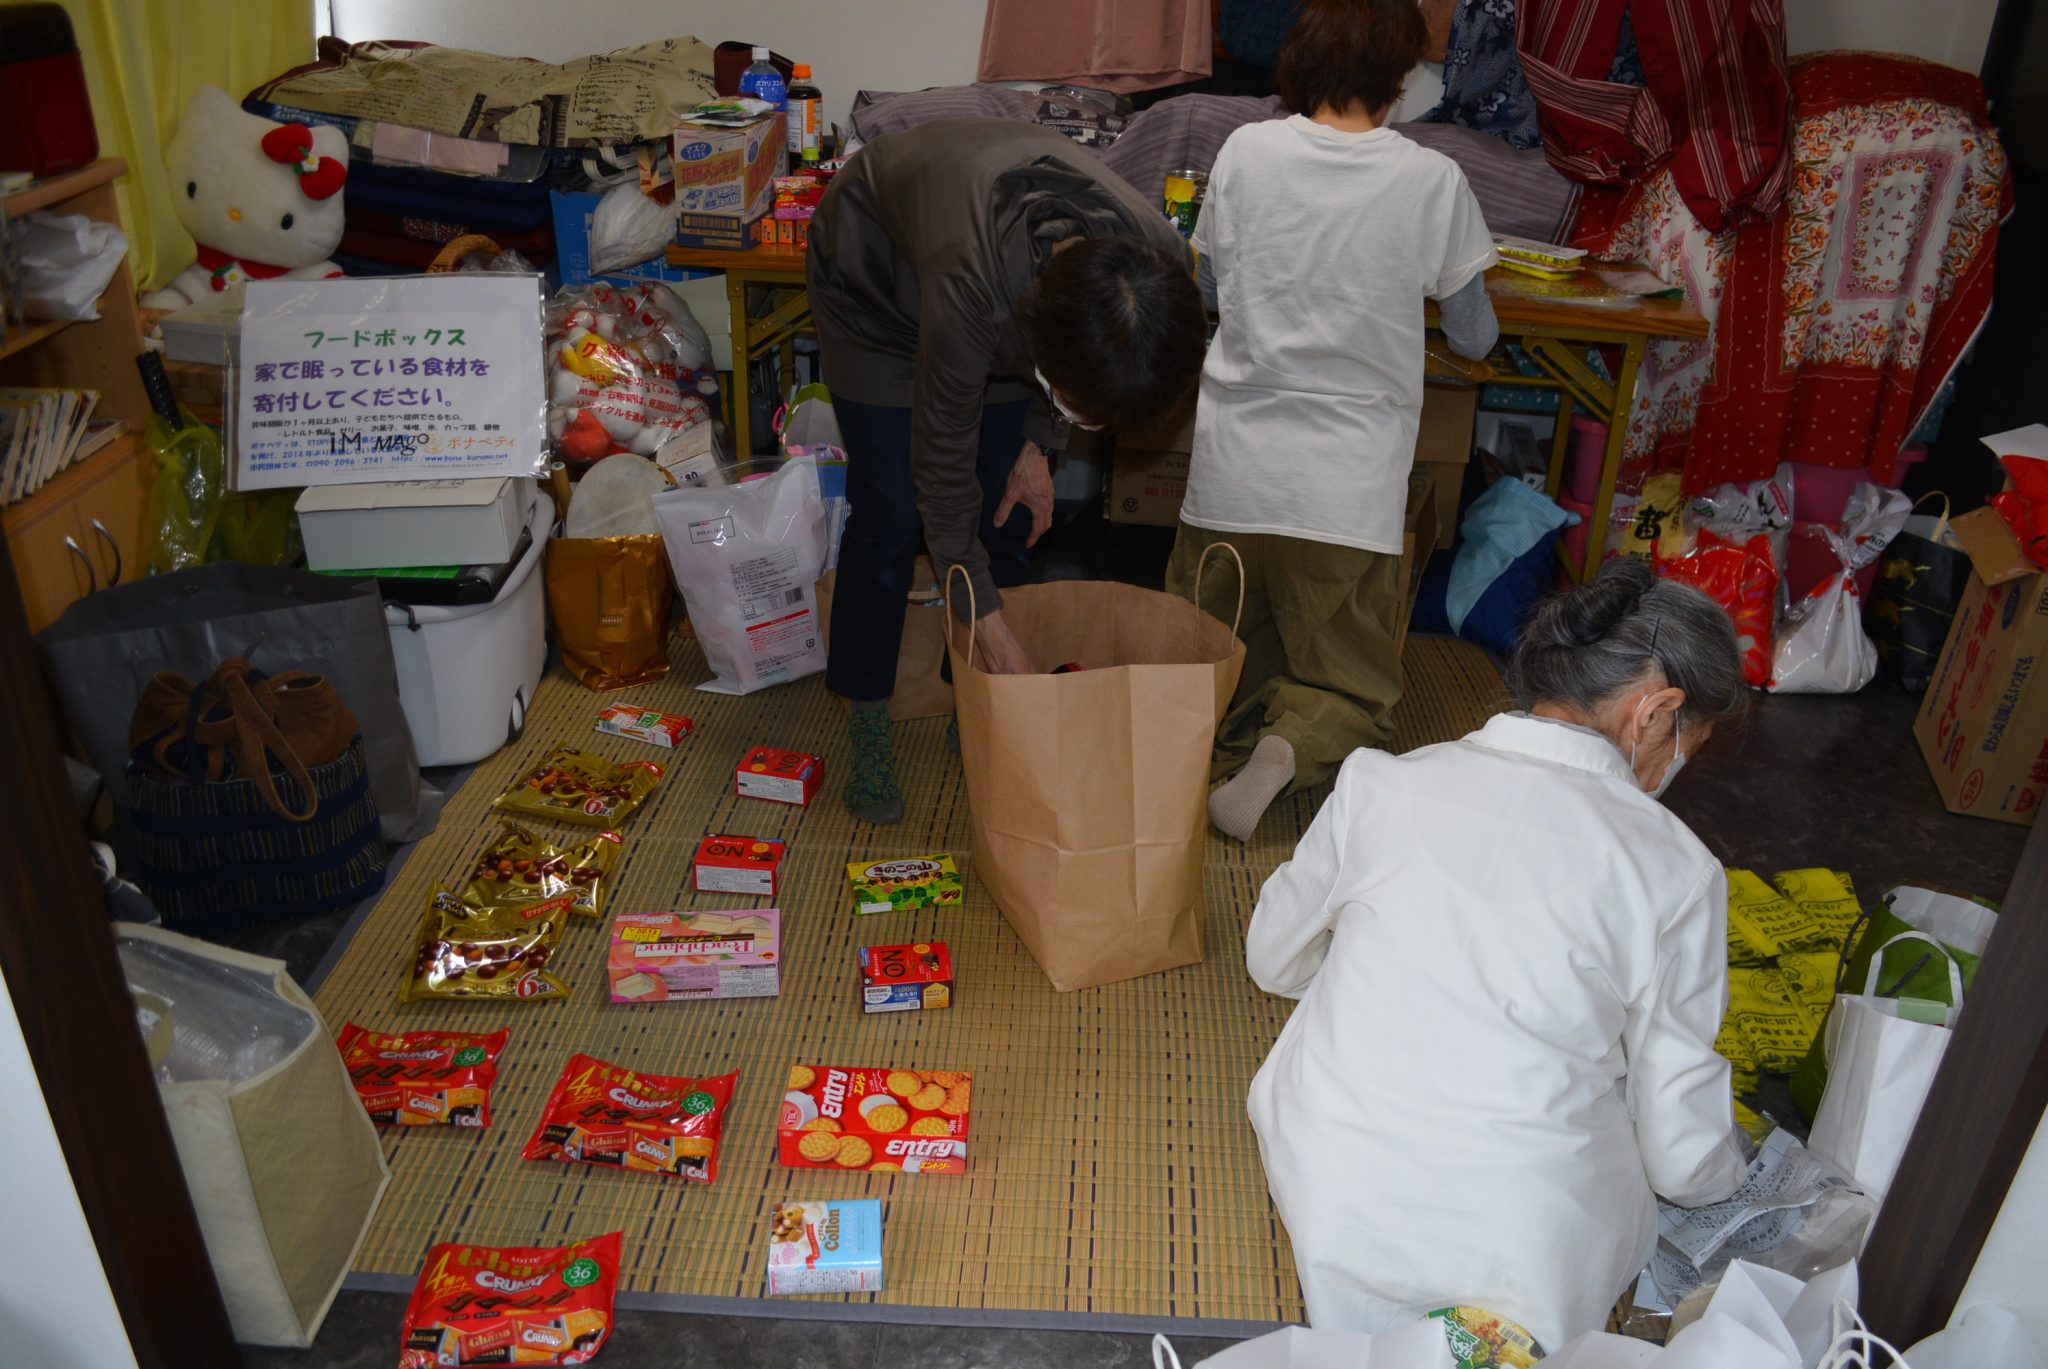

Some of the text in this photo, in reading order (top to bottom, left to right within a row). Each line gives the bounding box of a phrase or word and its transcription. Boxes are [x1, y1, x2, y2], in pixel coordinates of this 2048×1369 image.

[304, 328, 466, 349] フードボックス
[254, 356, 490, 383] 家で眠っている食材を
[253, 387, 455, 414] 寄付してください。
[873, 861, 933, 877] きのこの山
[378, 1049, 444, 1061] CRUNKY
[608, 1087, 675, 1110] CRUNKY
[820, 1068, 849, 1120] Entry
[409, 1097, 441, 1114] CRUNKY
[636, 1140, 669, 1161] CRUNKY
[884, 1138, 954, 1158] Entry
[824, 1208, 840, 1252] Collon
[475, 1269, 552, 1294] CRUNKY
[522, 1329, 562, 1347] CRUNKY
